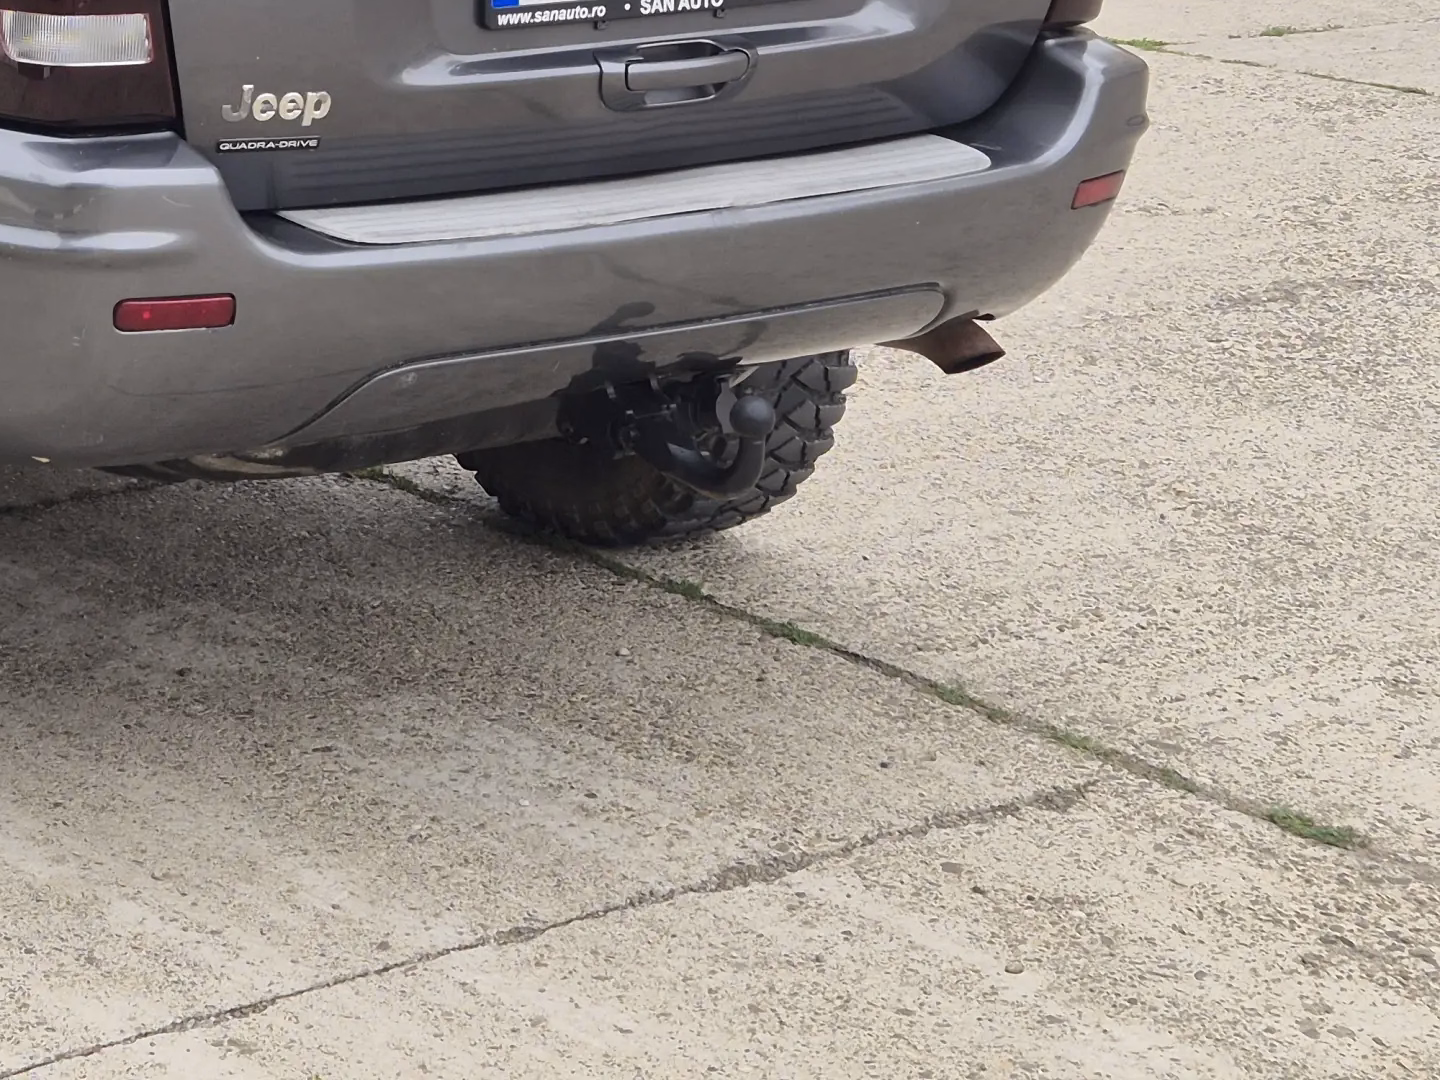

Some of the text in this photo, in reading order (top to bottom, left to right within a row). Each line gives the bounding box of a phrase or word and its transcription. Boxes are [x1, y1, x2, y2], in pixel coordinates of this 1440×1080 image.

[497, 5, 607, 26] www.sanauto.ro
[221, 84, 332, 127] Jeep
[220, 140, 318, 150] QUADRA-DRIVE
